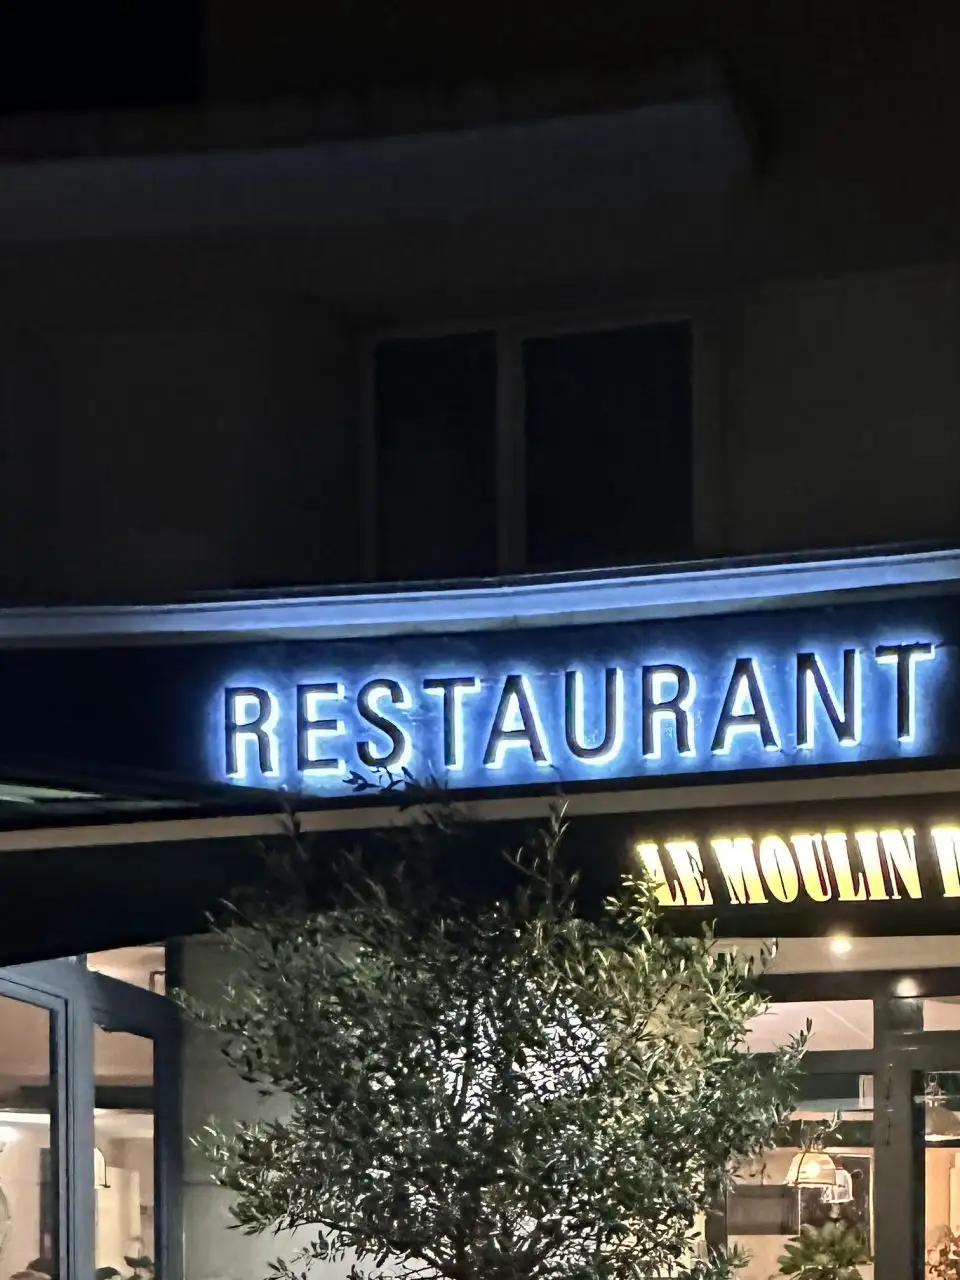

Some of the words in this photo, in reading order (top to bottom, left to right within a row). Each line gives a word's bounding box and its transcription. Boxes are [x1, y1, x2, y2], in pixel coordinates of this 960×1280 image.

[223, 641, 935, 779] RESTAURANT
[636, 840, 714, 907] LE
[711, 827, 923, 906] MOULIN
